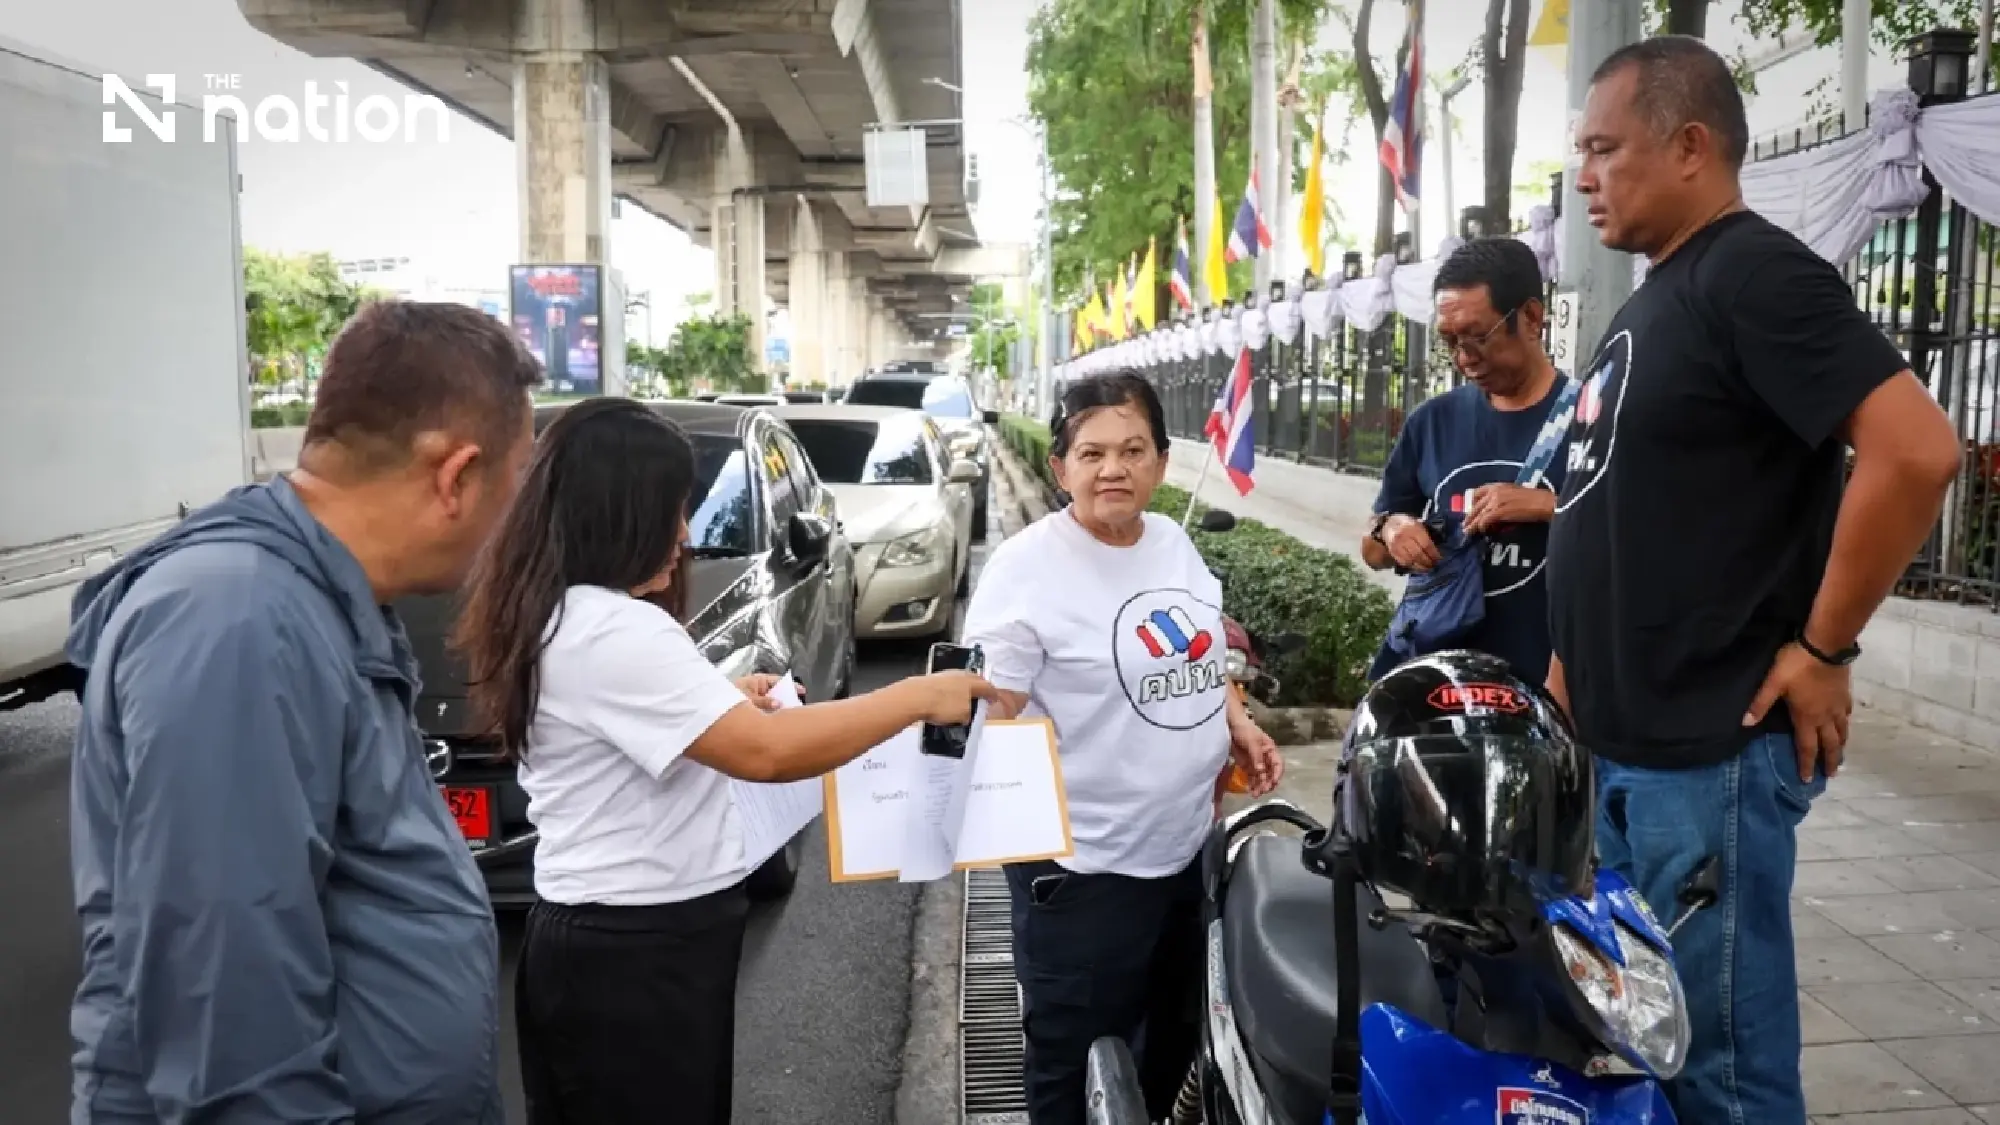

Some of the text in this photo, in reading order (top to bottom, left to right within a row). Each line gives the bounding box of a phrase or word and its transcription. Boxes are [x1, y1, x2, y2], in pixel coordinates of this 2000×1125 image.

[1138, 659, 1227, 705] คปท.
[1441, 687, 1516, 707] INDEX
[443, 790, 479, 818] 52
